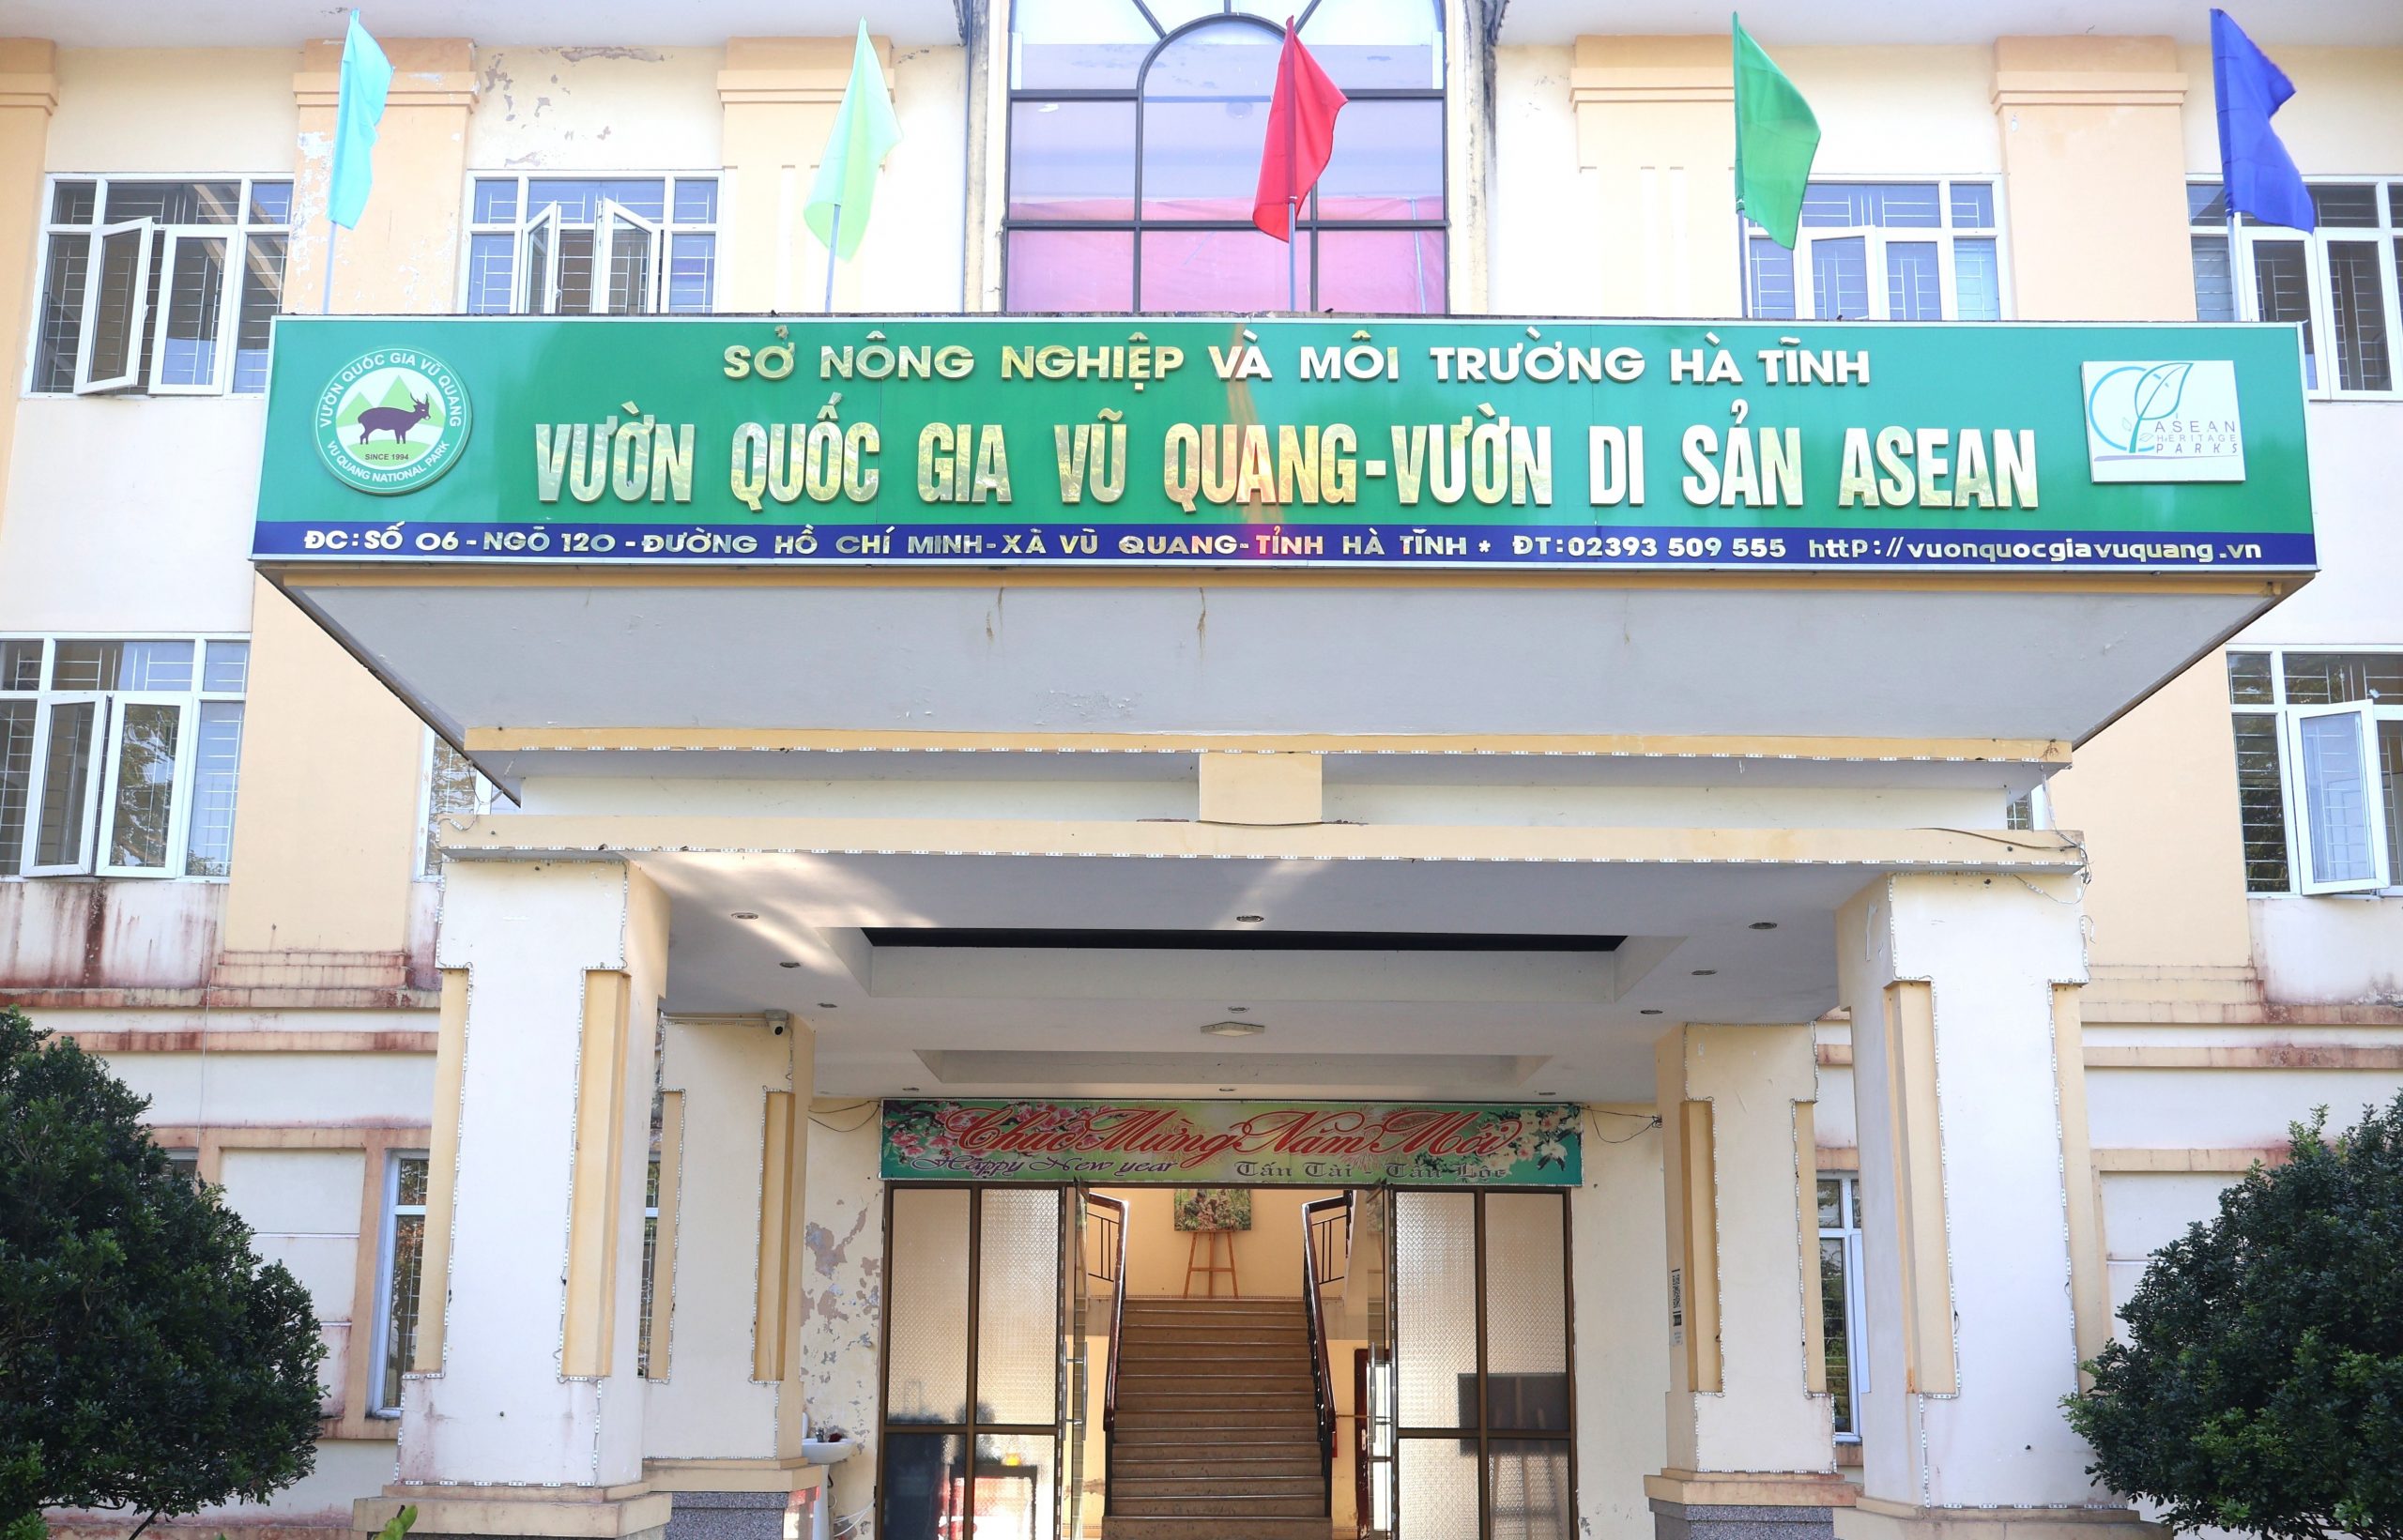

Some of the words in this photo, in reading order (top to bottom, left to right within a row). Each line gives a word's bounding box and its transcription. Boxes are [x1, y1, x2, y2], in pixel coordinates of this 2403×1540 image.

[724, 325, 795, 380] SỞ
[819, 330, 974, 380] NÔNG
[1001, 331, 1185, 392] NGHIỆP
[1208, 328, 1272, 382] VÀ
[1300, 329, 1400, 382] MÔI
[1430, 326, 1645, 384] TRƯỜNG
[1670, 331, 1744, 386] HÀ
[1758, 336, 1871, 387] TĨNH
[319, 382, 344, 428] VƯỜN
[342, 354, 385, 382] QUỐC
[390, 352, 416, 366] GIA
[421, 358, 441, 376] VŨ
[438, 375, 463, 427] QUANG
[2154, 420, 2236, 433] ASEAN
[2156, 434, 2236, 442] HERITAGE
[336, 454, 371, 480] QUANG
[372, 465, 427, 482] NATIONAL
[425, 441, 450, 466] PARK
[534, 401, 694, 504] VƯỜN
[729, 390, 880, 512] QUỐC
[916, 422, 1013, 504] GIA
[1053, 406, 1127, 504] VŨ
[1589, 425, 1645, 507] DI
[1680, 398, 1803, 508] SẢN
[1838, 425, 2040, 509] ASEAN
[2156, 443, 2238, 454] PARKS
[774, 524, 819, 555] HỒ
[835, 526, 895, 555] CHÍ
[1059, 527, 1098, 555] VŨ
[1341, 527, 1385, 556] HÀ
[1668, 538, 1722, 557] 509
[1732, 538, 1787, 558] 555
[911, 1153, 1027, 1178] Happy
[1029, 1155, 1114, 1172] New
[1111, 1161, 1178, 1178] year
